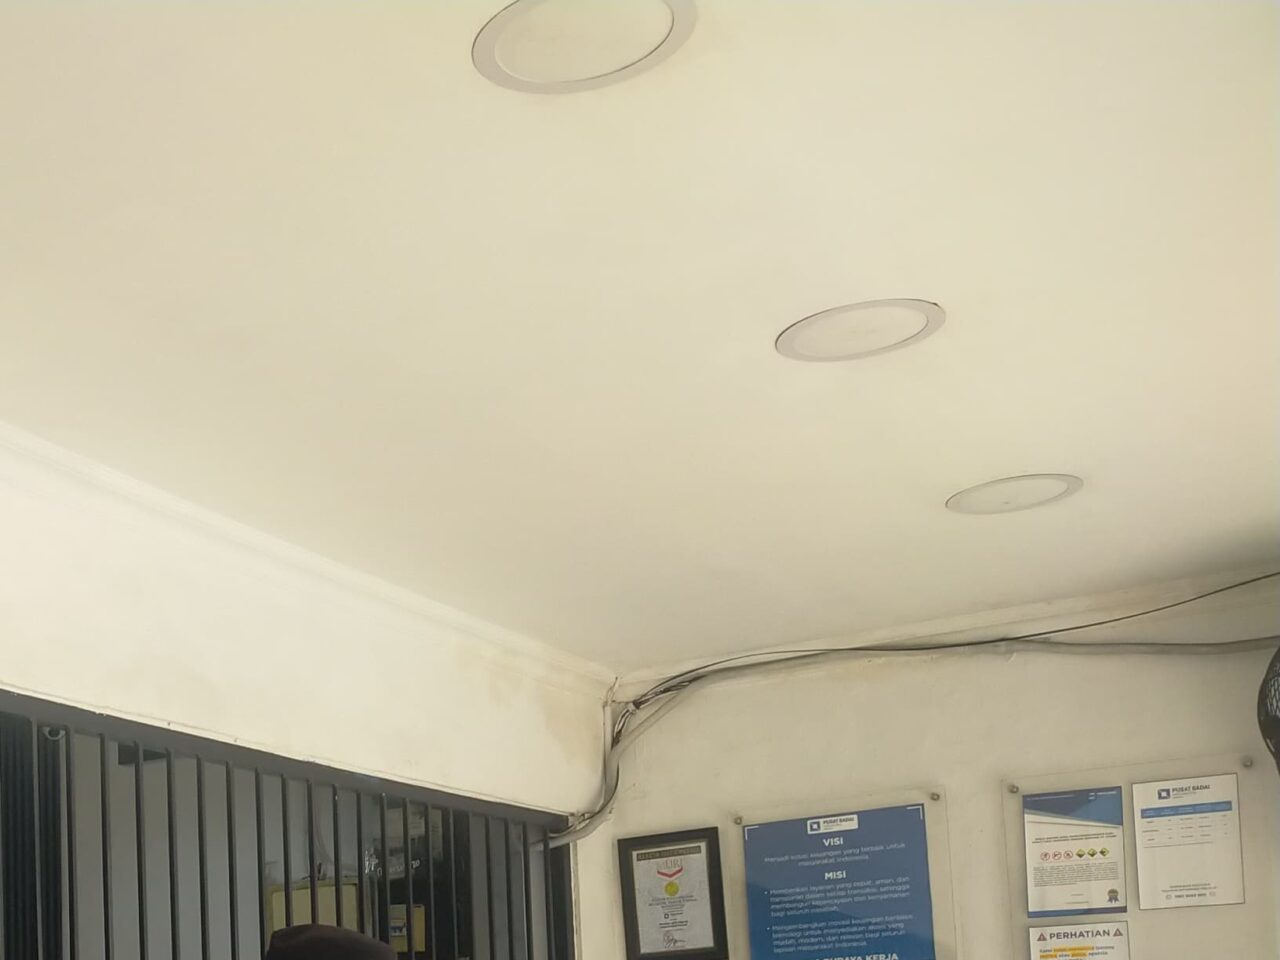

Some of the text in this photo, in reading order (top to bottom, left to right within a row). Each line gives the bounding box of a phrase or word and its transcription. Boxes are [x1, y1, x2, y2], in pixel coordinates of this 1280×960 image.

[823, 836, 844, 847] VISI
[824, 870, 847, 881] MISI
[1049, 928, 1111, 941] PERHATIAN
